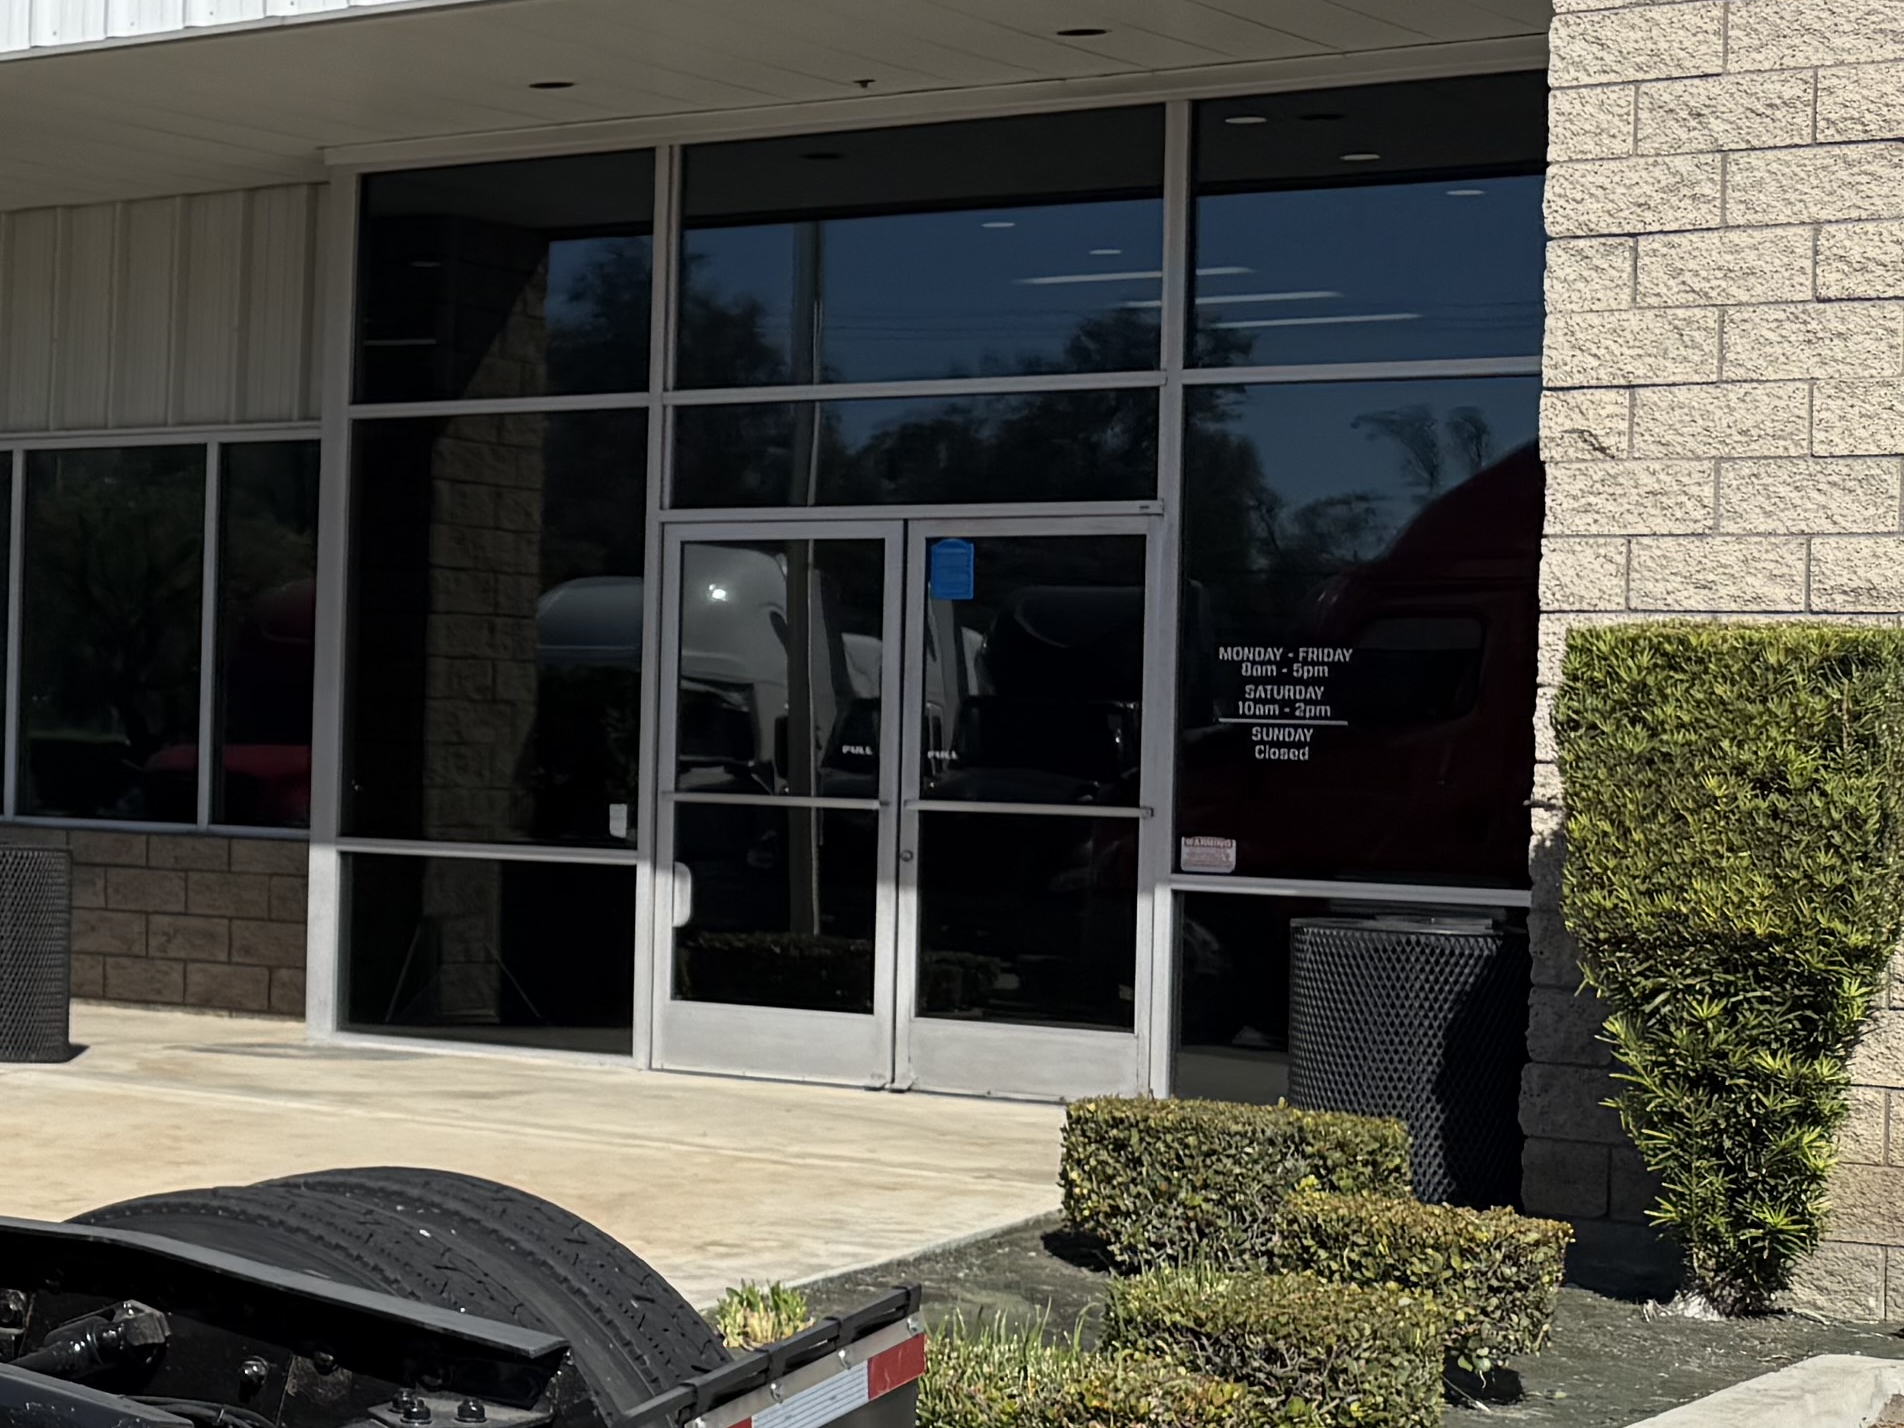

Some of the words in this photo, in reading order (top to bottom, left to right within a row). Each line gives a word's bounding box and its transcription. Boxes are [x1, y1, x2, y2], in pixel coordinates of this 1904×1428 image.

[1218, 646, 1283, 662] MONDAY
[1298, 647, 1353, 662] FRIDAY
[1292, 663, 1329, 679] 5pm
[1244, 684, 1324, 700] SATURDAY
[1238, 701, 1279, 716] 10am
[1294, 702, 1331, 718] 2pm
[1251, 726, 1313, 742] SUNDAY
[842, 745, 873, 756] PULL
[1254, 744, 1309, 761] Closed
